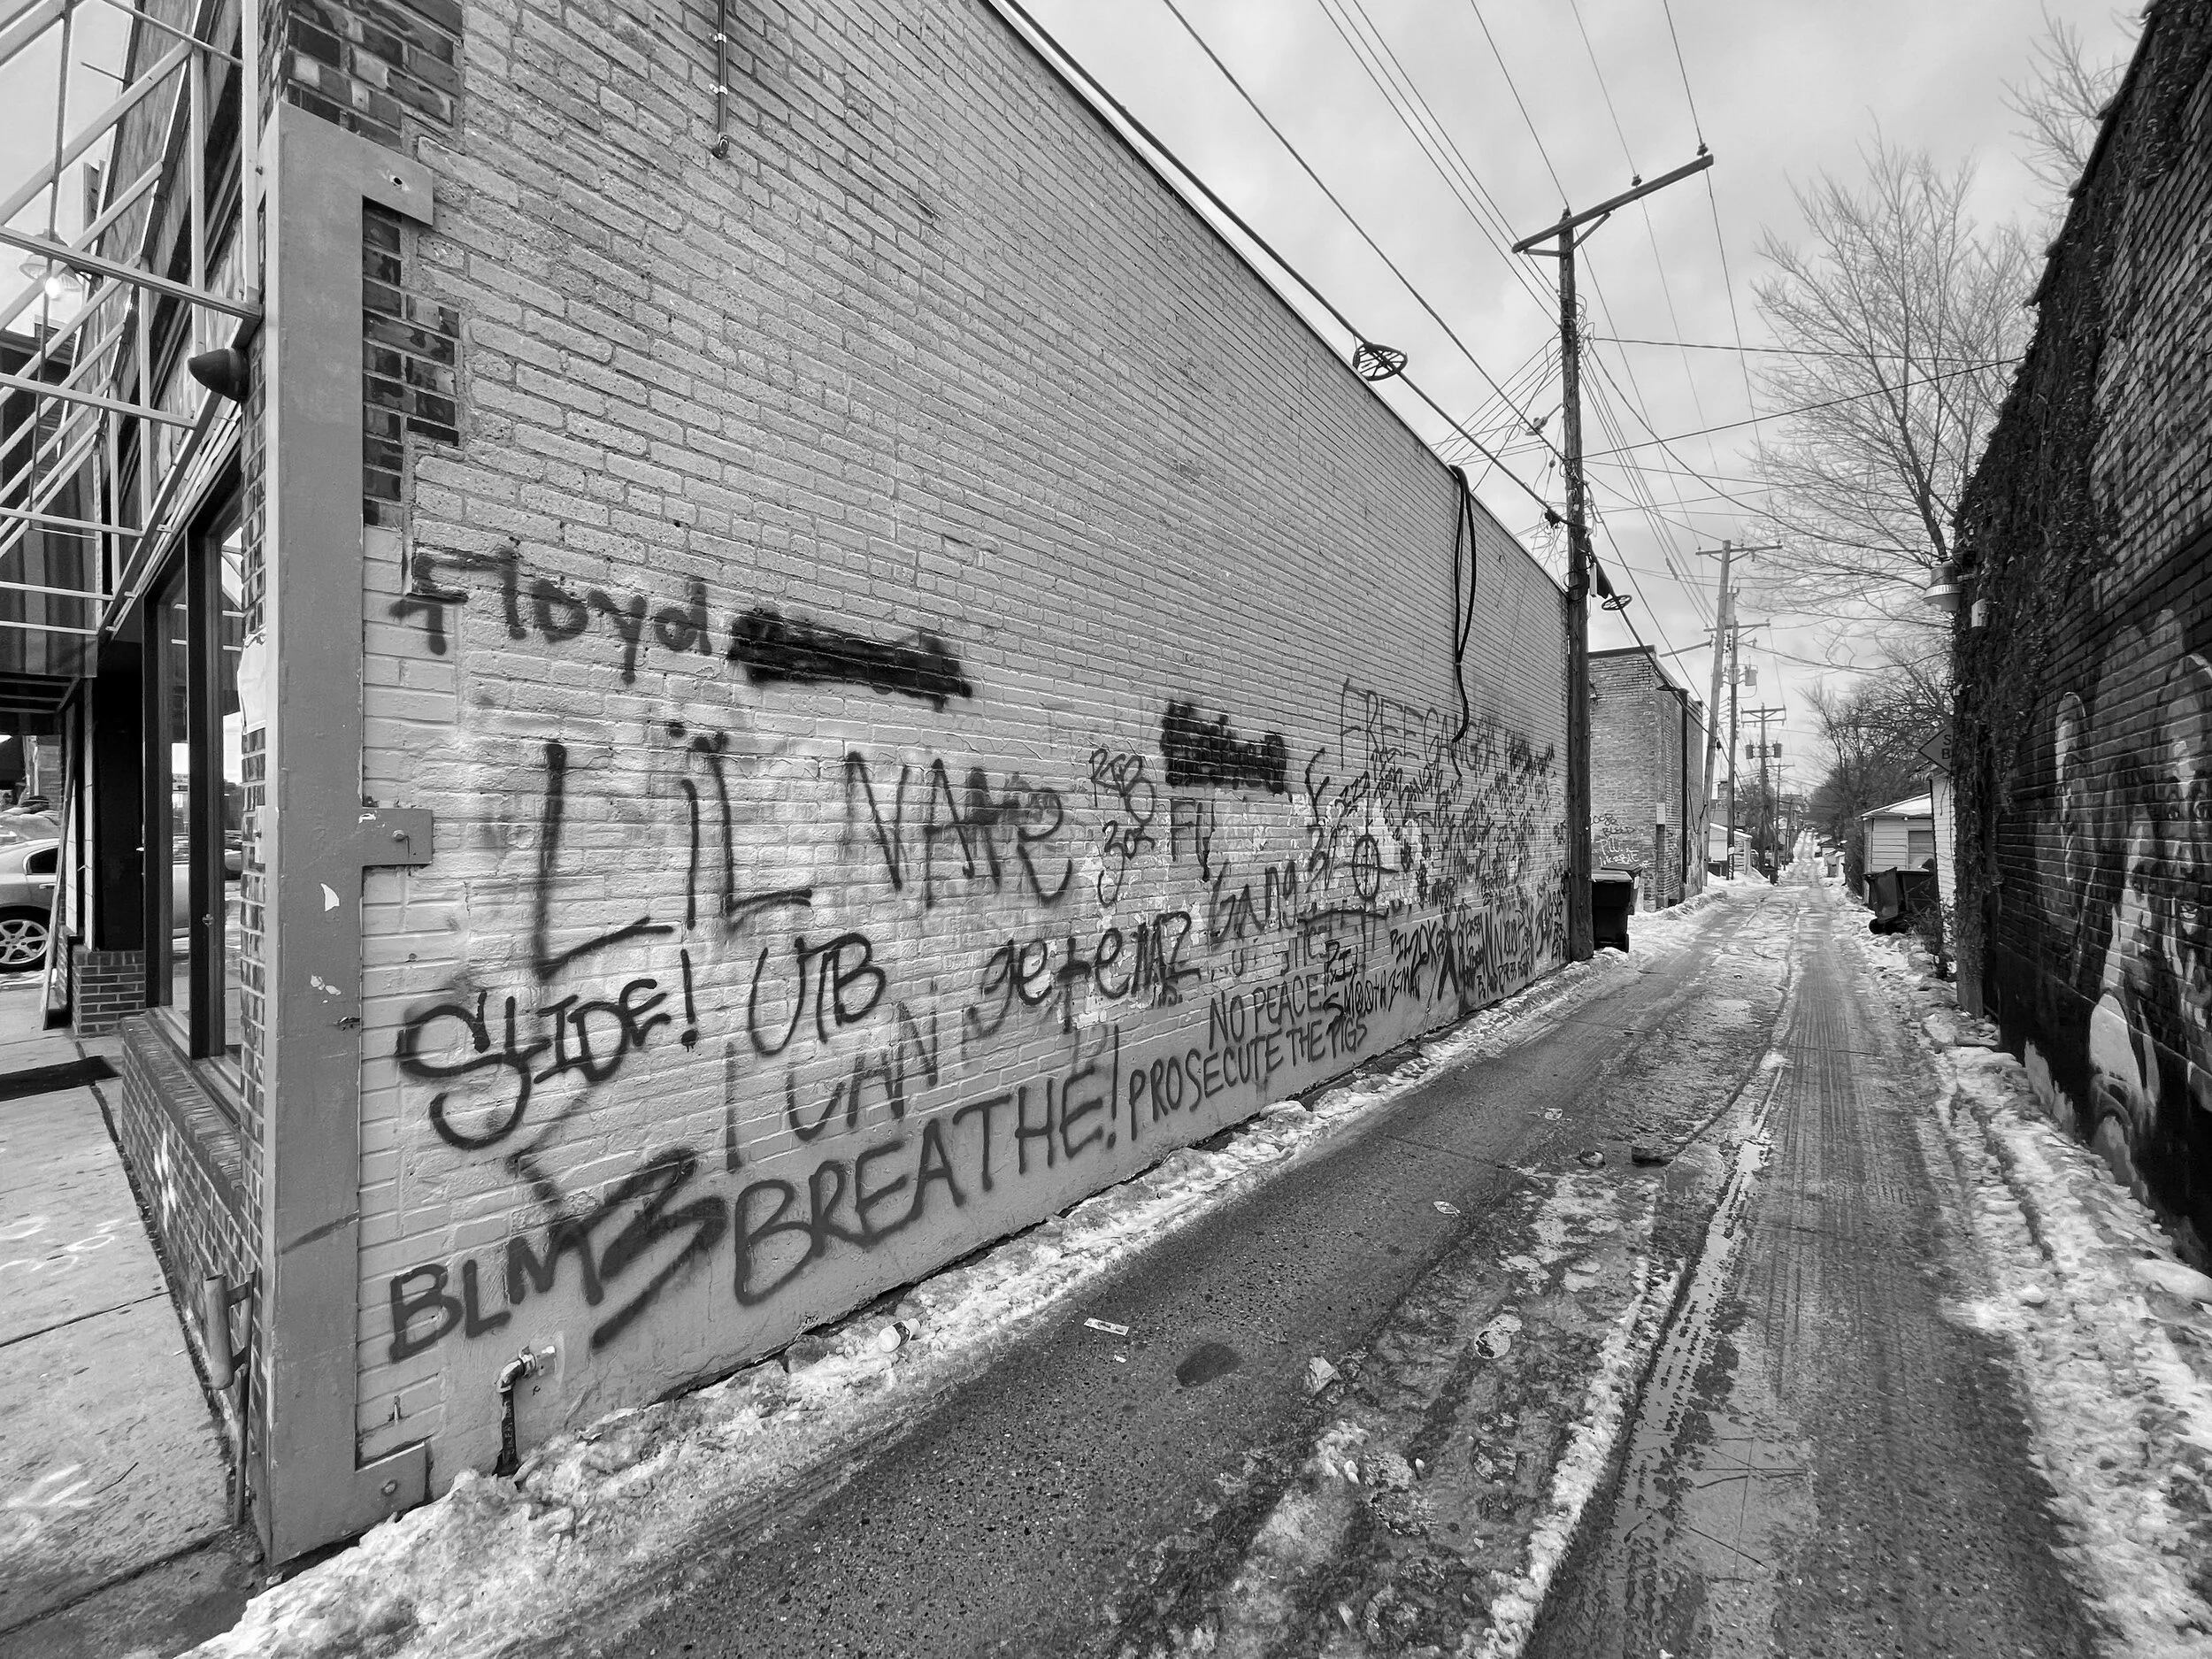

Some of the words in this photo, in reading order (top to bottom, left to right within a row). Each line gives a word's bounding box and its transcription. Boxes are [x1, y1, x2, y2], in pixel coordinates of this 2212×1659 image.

[1208, 989, 1246, 1053] NO
[1252, 974, 1324, 1034] PEACE
[1128, 1026, 1284, 1142] PROSECUTE
[1285, 1019, 1325, 1067] THE
[1327, 1016, 1369, 1060] PIGS
